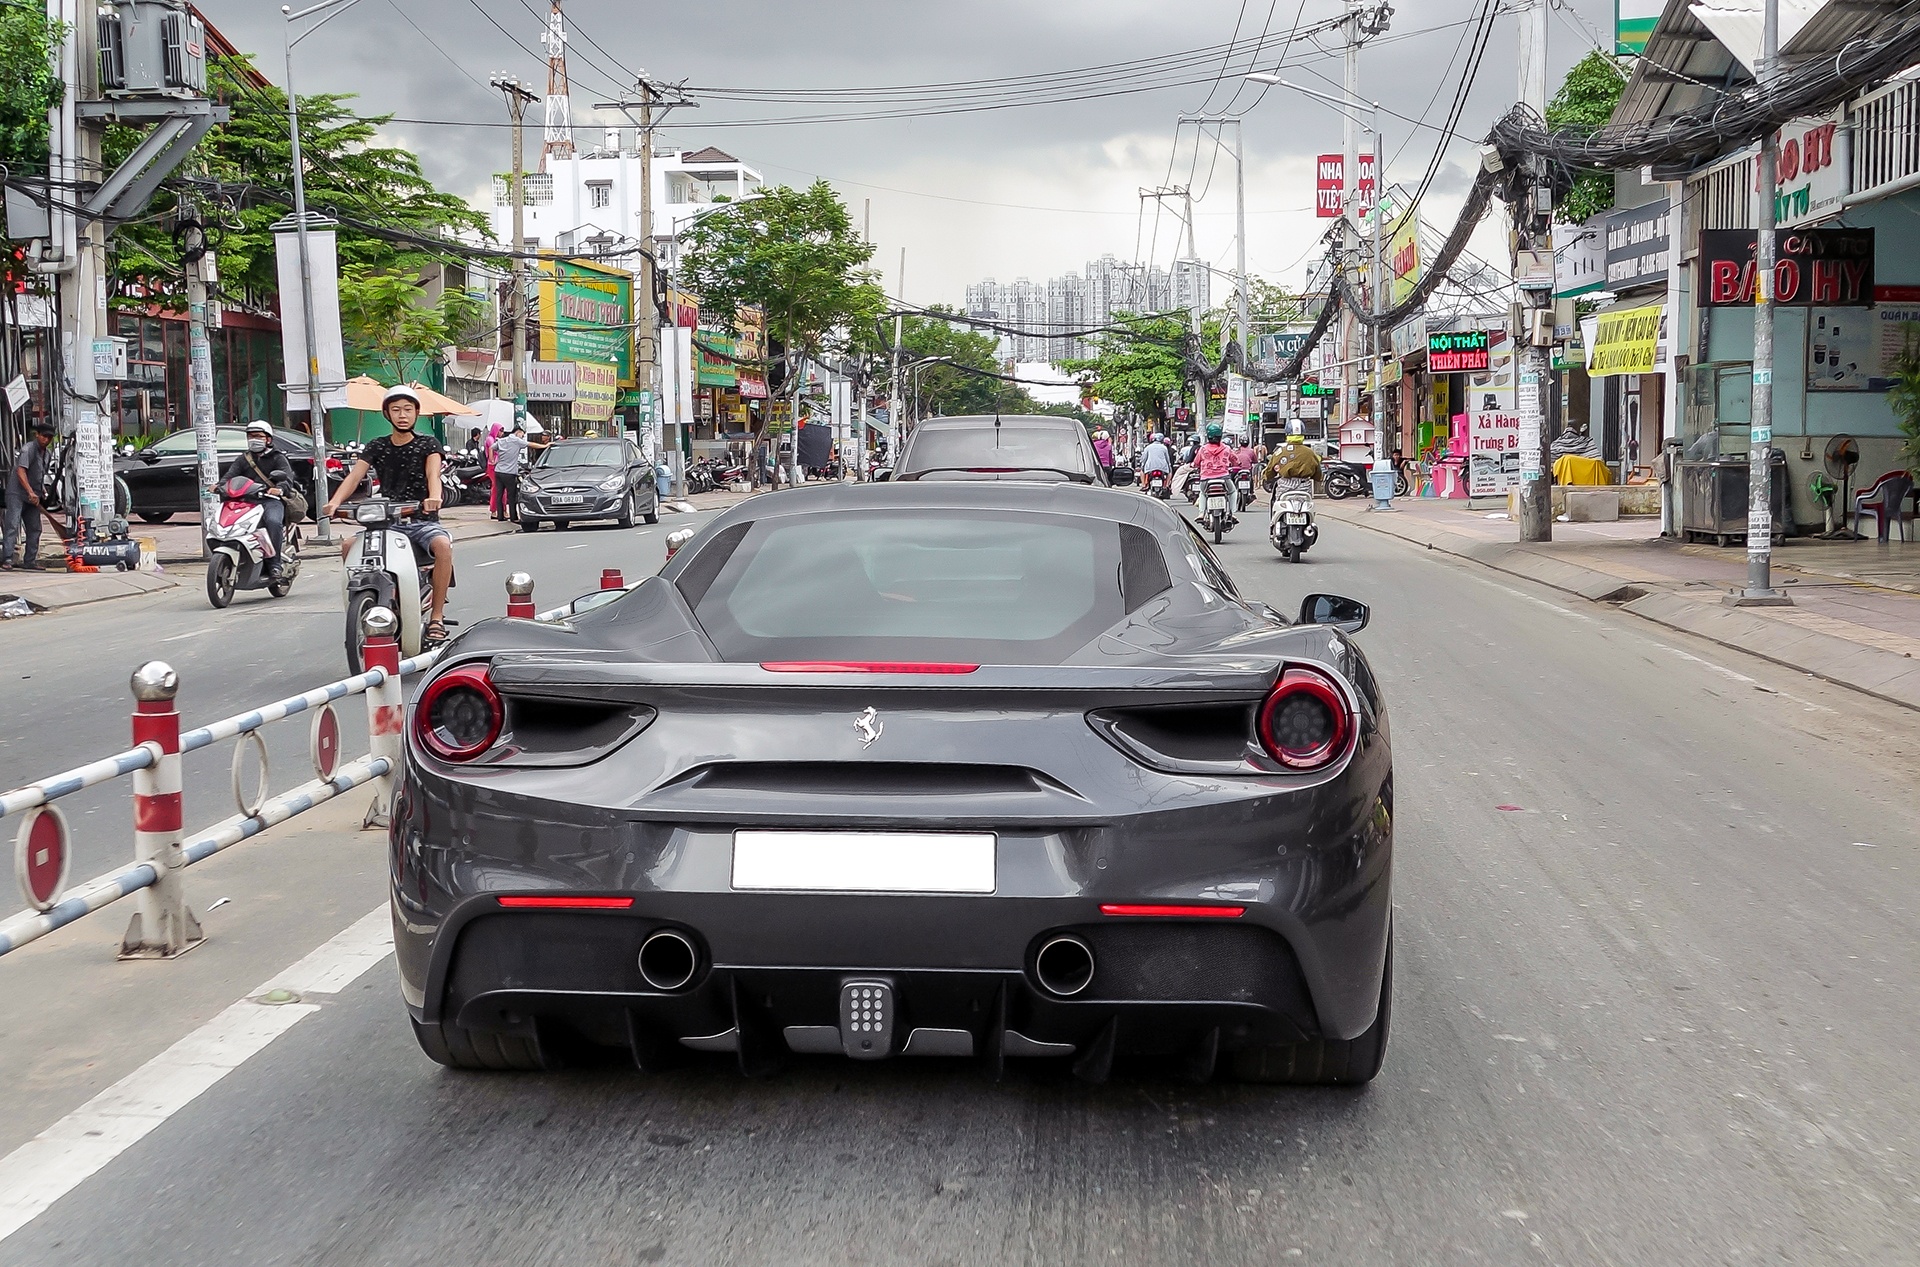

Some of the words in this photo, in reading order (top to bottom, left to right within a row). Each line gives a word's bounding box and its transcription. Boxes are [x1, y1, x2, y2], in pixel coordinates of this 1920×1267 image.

[1802, 121, 1837, 174] HY
[1320, 162, 1343, 180] NHA
[1812, 258, 1870, 303] HY
[1430, 335, 1452, 351] NỘI
[1454, 332, 1487, 348] THẤT
[1430, 350, 1461, 370] THIÊN
[1462, 348, 1488, 369] PHÁT
[540, 369, 554, 384] HAI
[1478, 413, 1491, 429] Xả
[1473, 435, 1504, 451] Trưng
